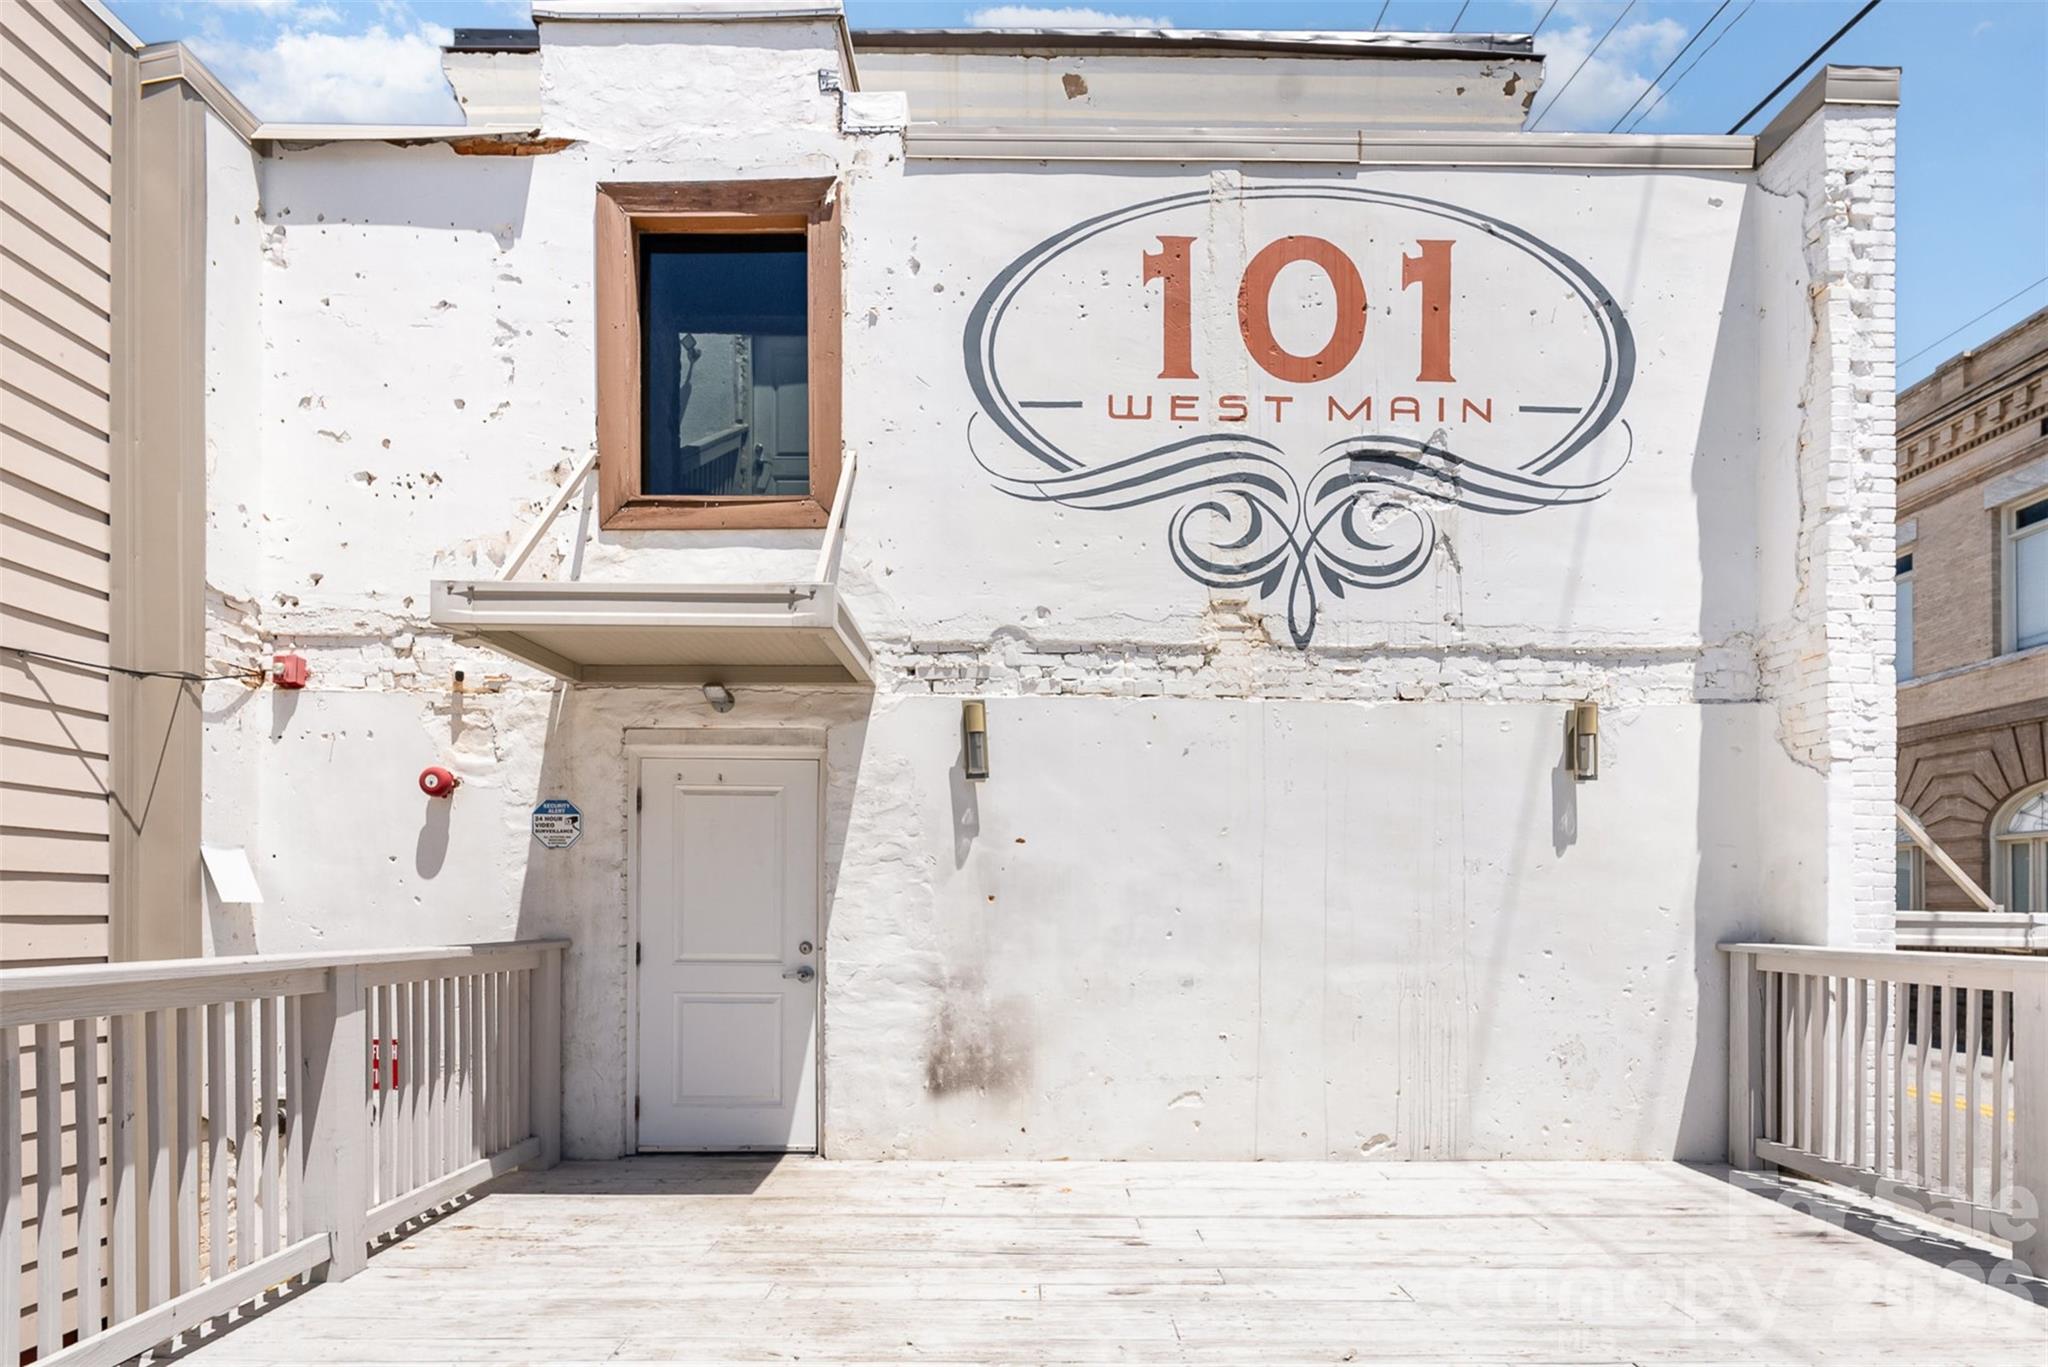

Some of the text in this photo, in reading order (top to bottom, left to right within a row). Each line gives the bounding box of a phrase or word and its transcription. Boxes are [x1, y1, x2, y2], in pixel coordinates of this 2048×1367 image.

[1143, 235, 1456, 383] 101
[1108, 395, 1491, 423] WEST MAIN
